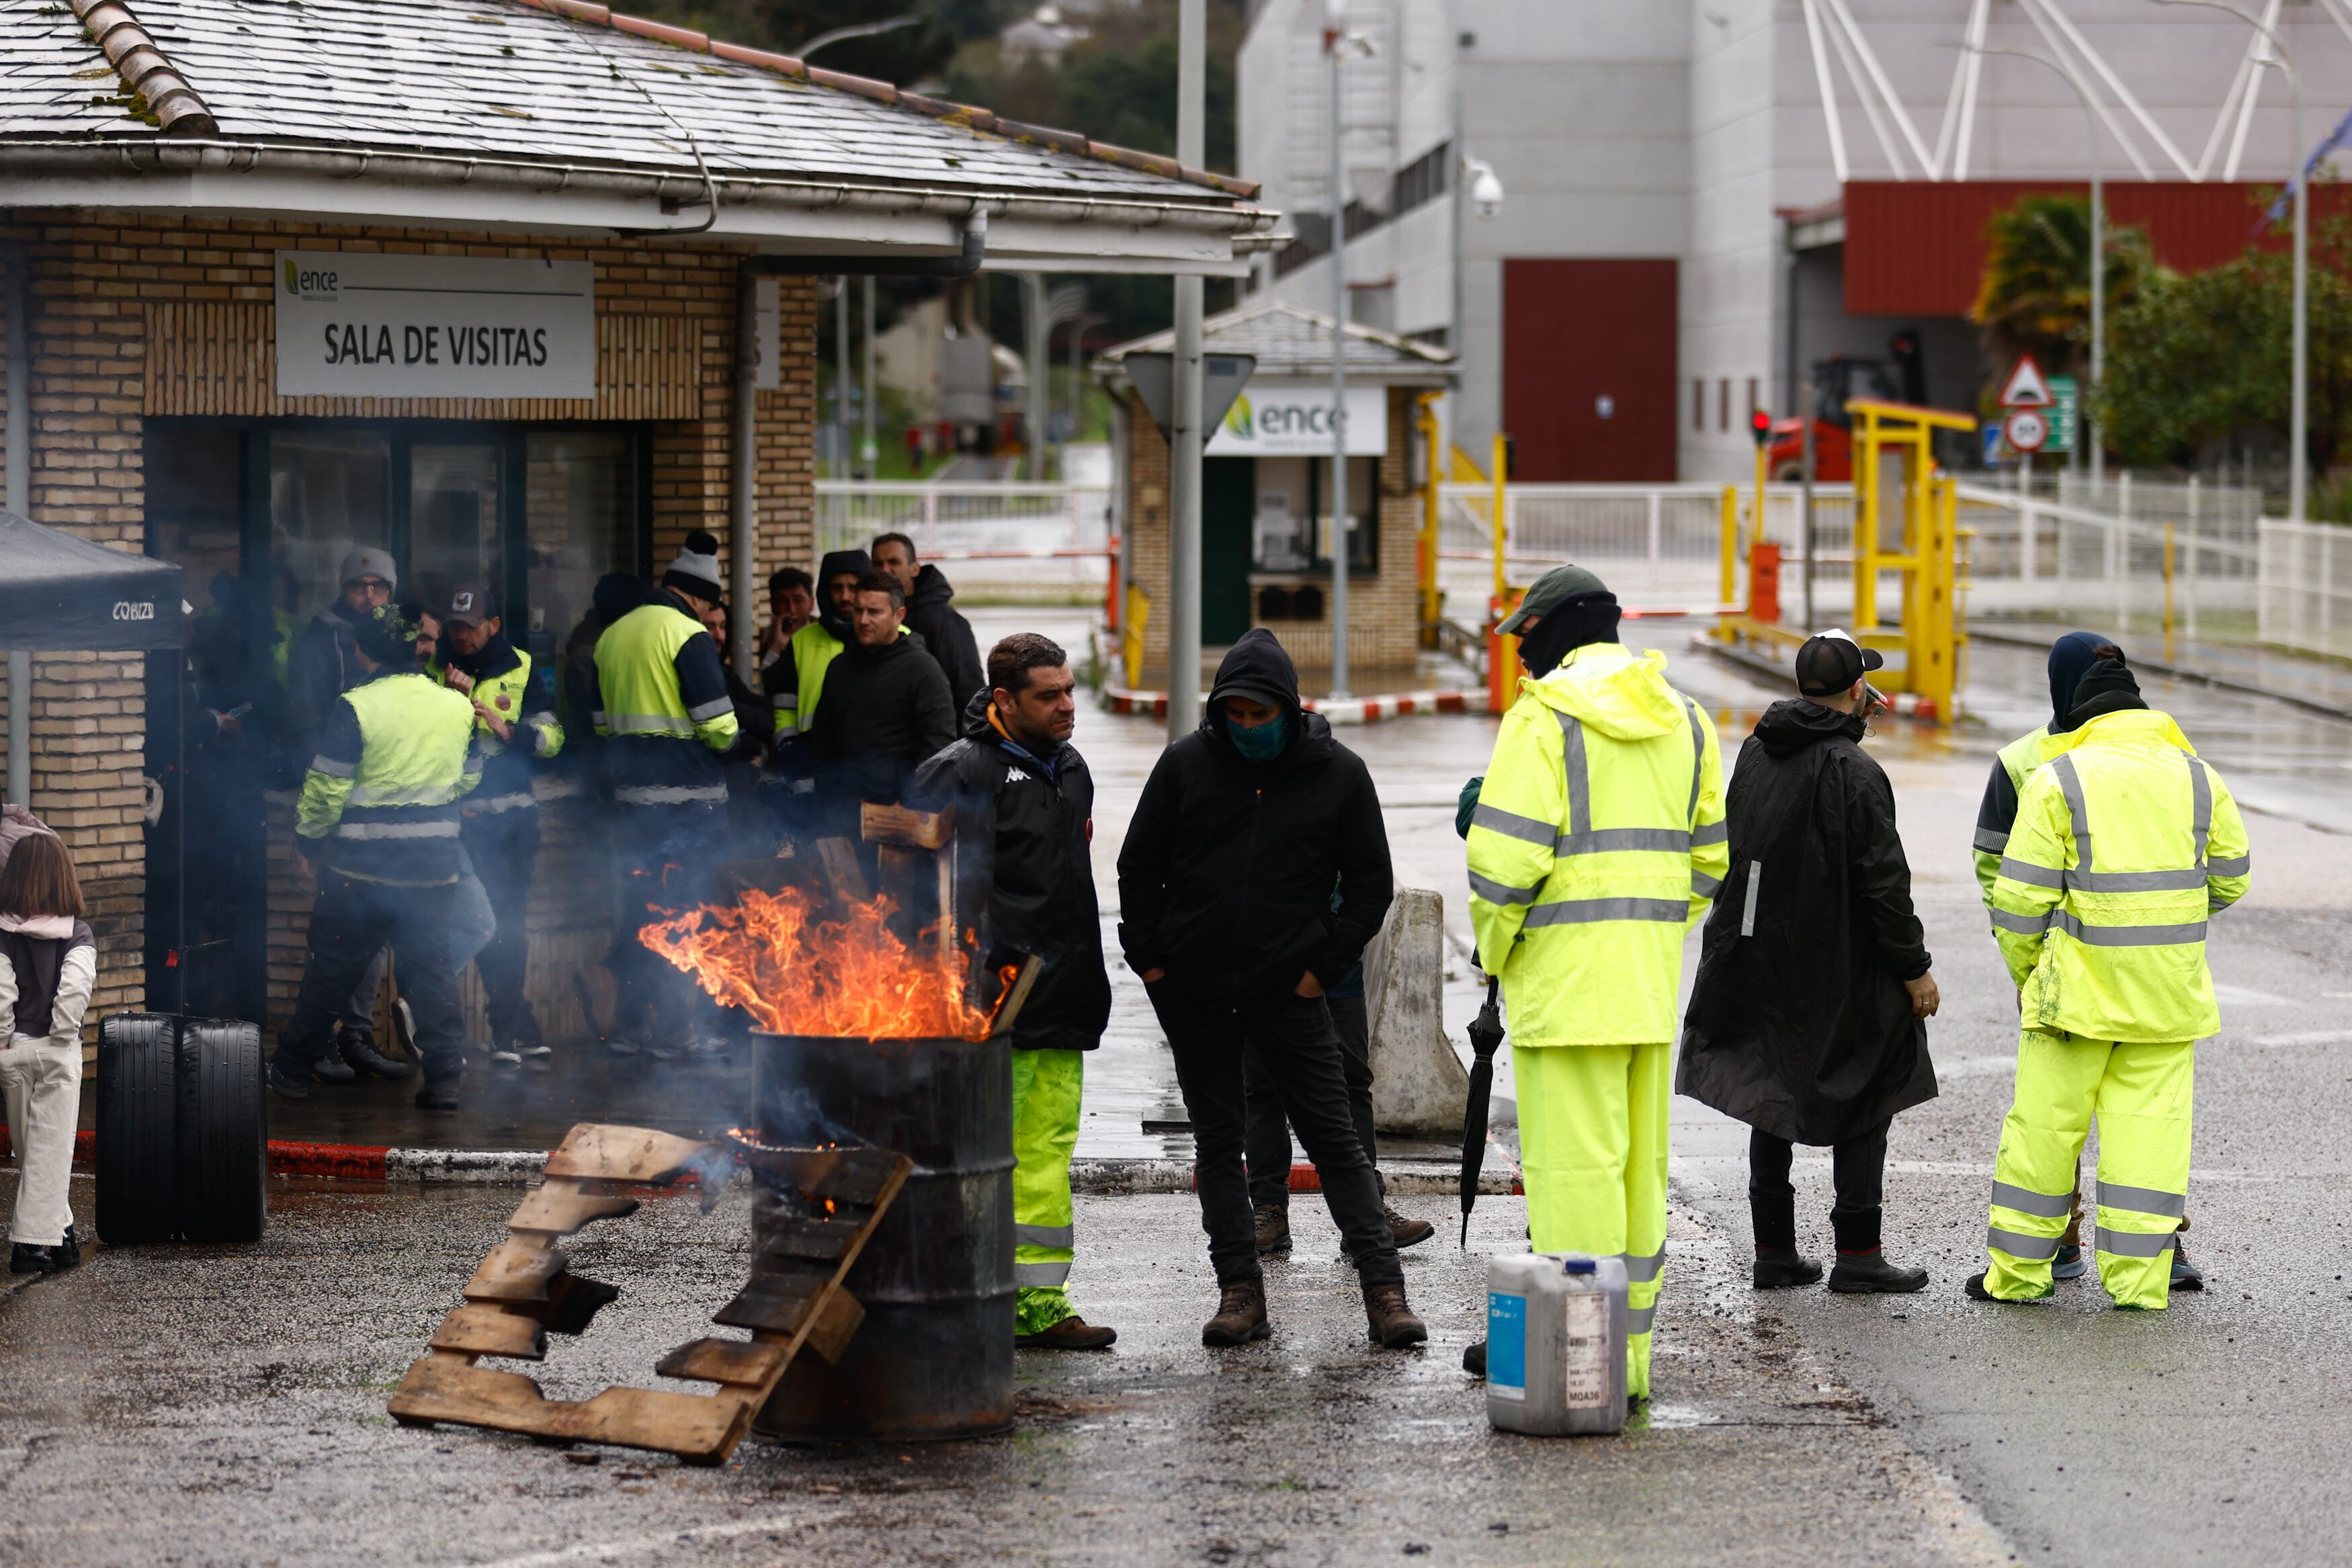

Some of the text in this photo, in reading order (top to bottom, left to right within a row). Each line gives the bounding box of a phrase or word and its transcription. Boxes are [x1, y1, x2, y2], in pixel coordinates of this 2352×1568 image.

[300, 271, 338, 292] ence
[325, 323, 548, 367] SALA DE VISITAS
[1259, 404, 1349, 434] ence
